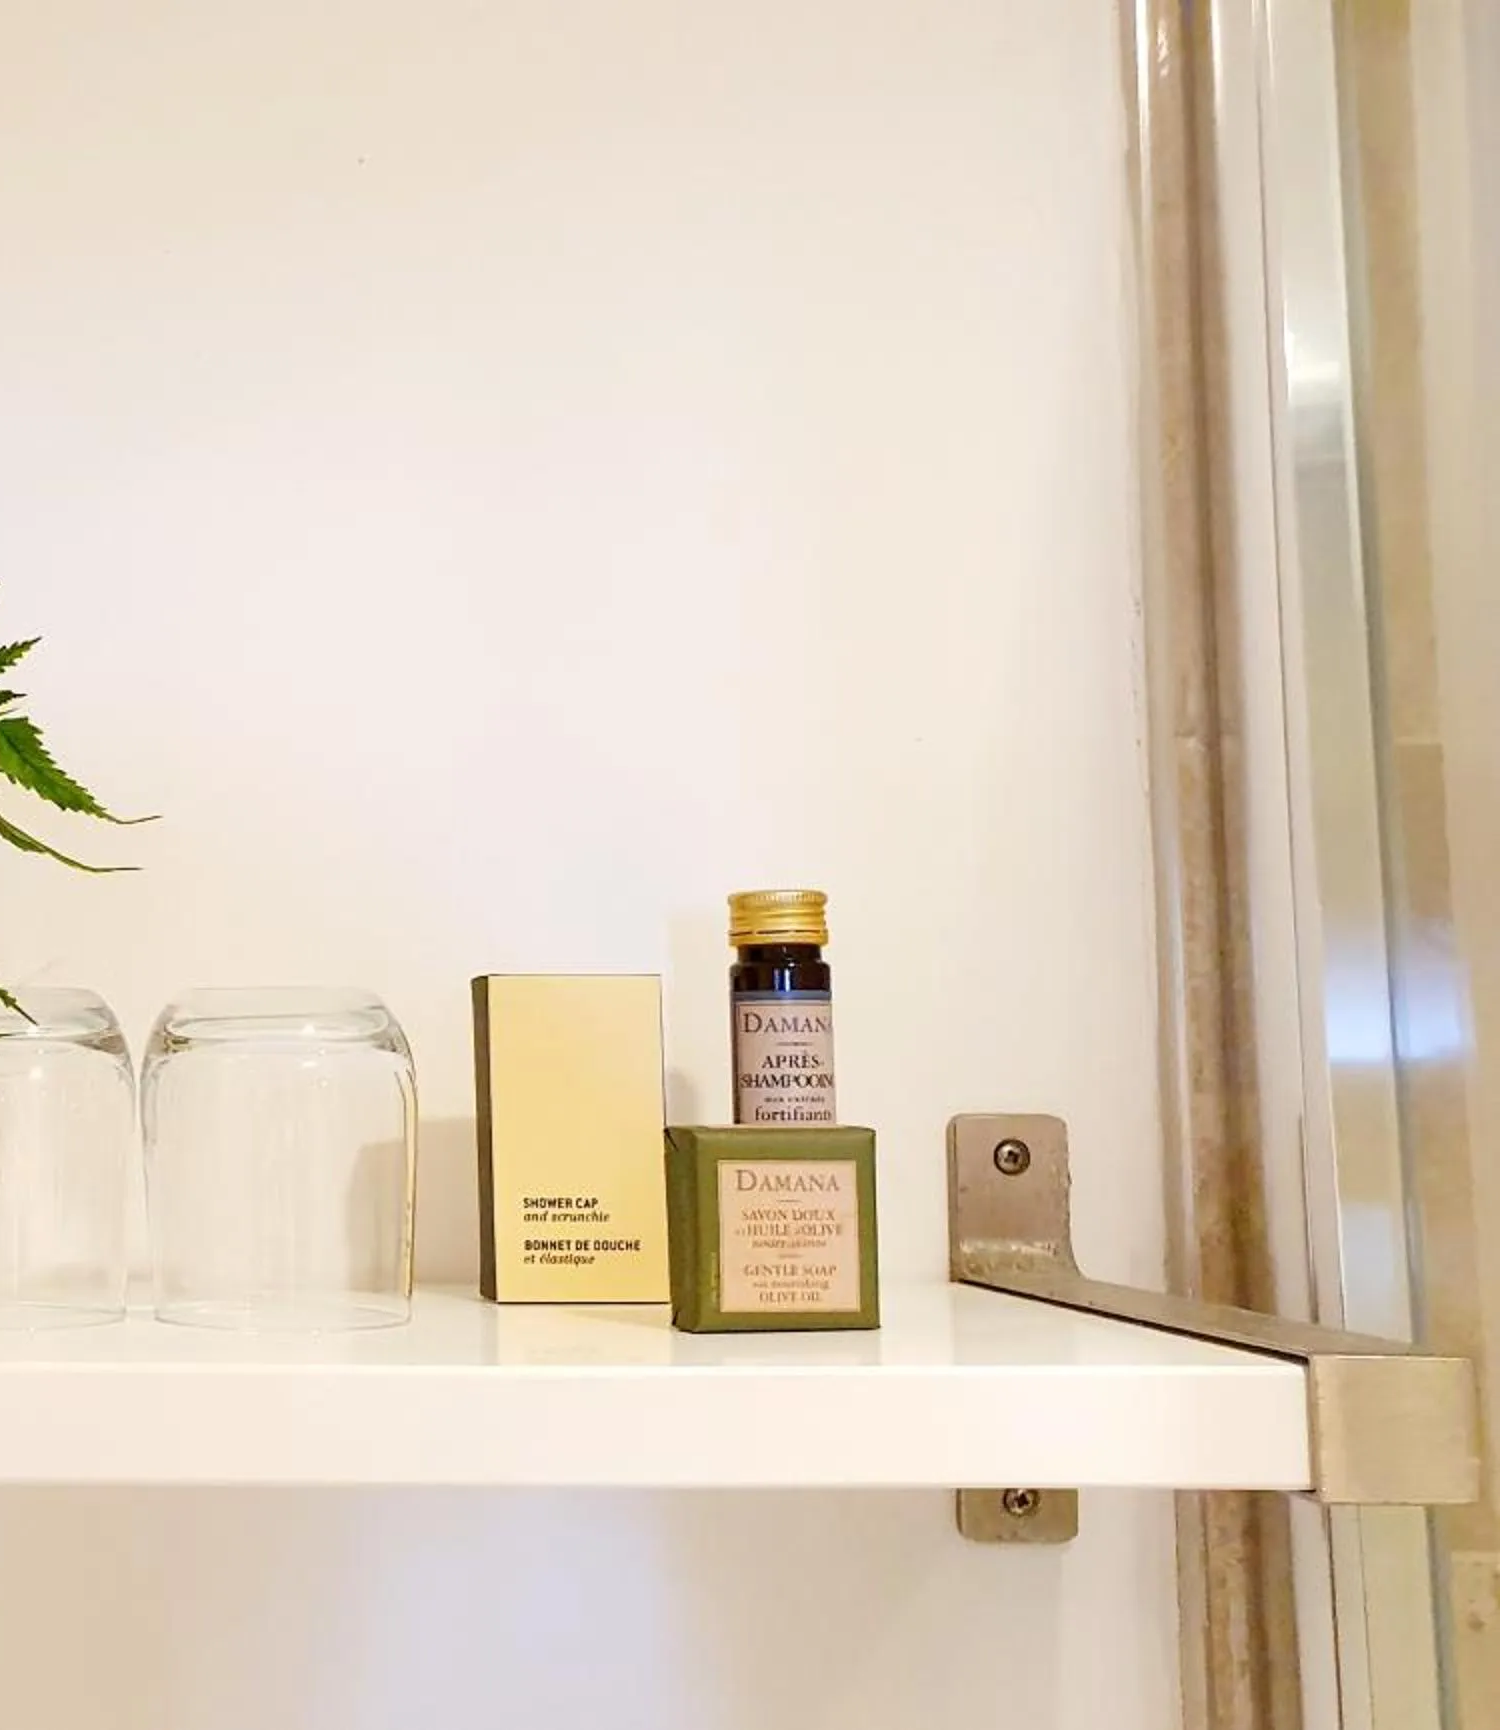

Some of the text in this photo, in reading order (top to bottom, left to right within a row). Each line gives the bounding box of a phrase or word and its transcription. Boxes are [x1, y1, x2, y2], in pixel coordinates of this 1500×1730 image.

[742, 1011, 832, 1033] DAMAN
[735, 1168, 841, 1192] DAMANA
[522, 1197, 599, 1209] SHOWER CAP
[523, 1210, 611, 1222] and scrunchie
[741, 1208, 836, 1221] SAVON DOUX
[523, 1239, 642, 1251] BONNET DE DOUCHE
[523, 1253, 596, 1267] et élastique
[742, 1264, 837, 1277] GENTLE SOAP
[759, 1291, 798, 1303] OLIVE
